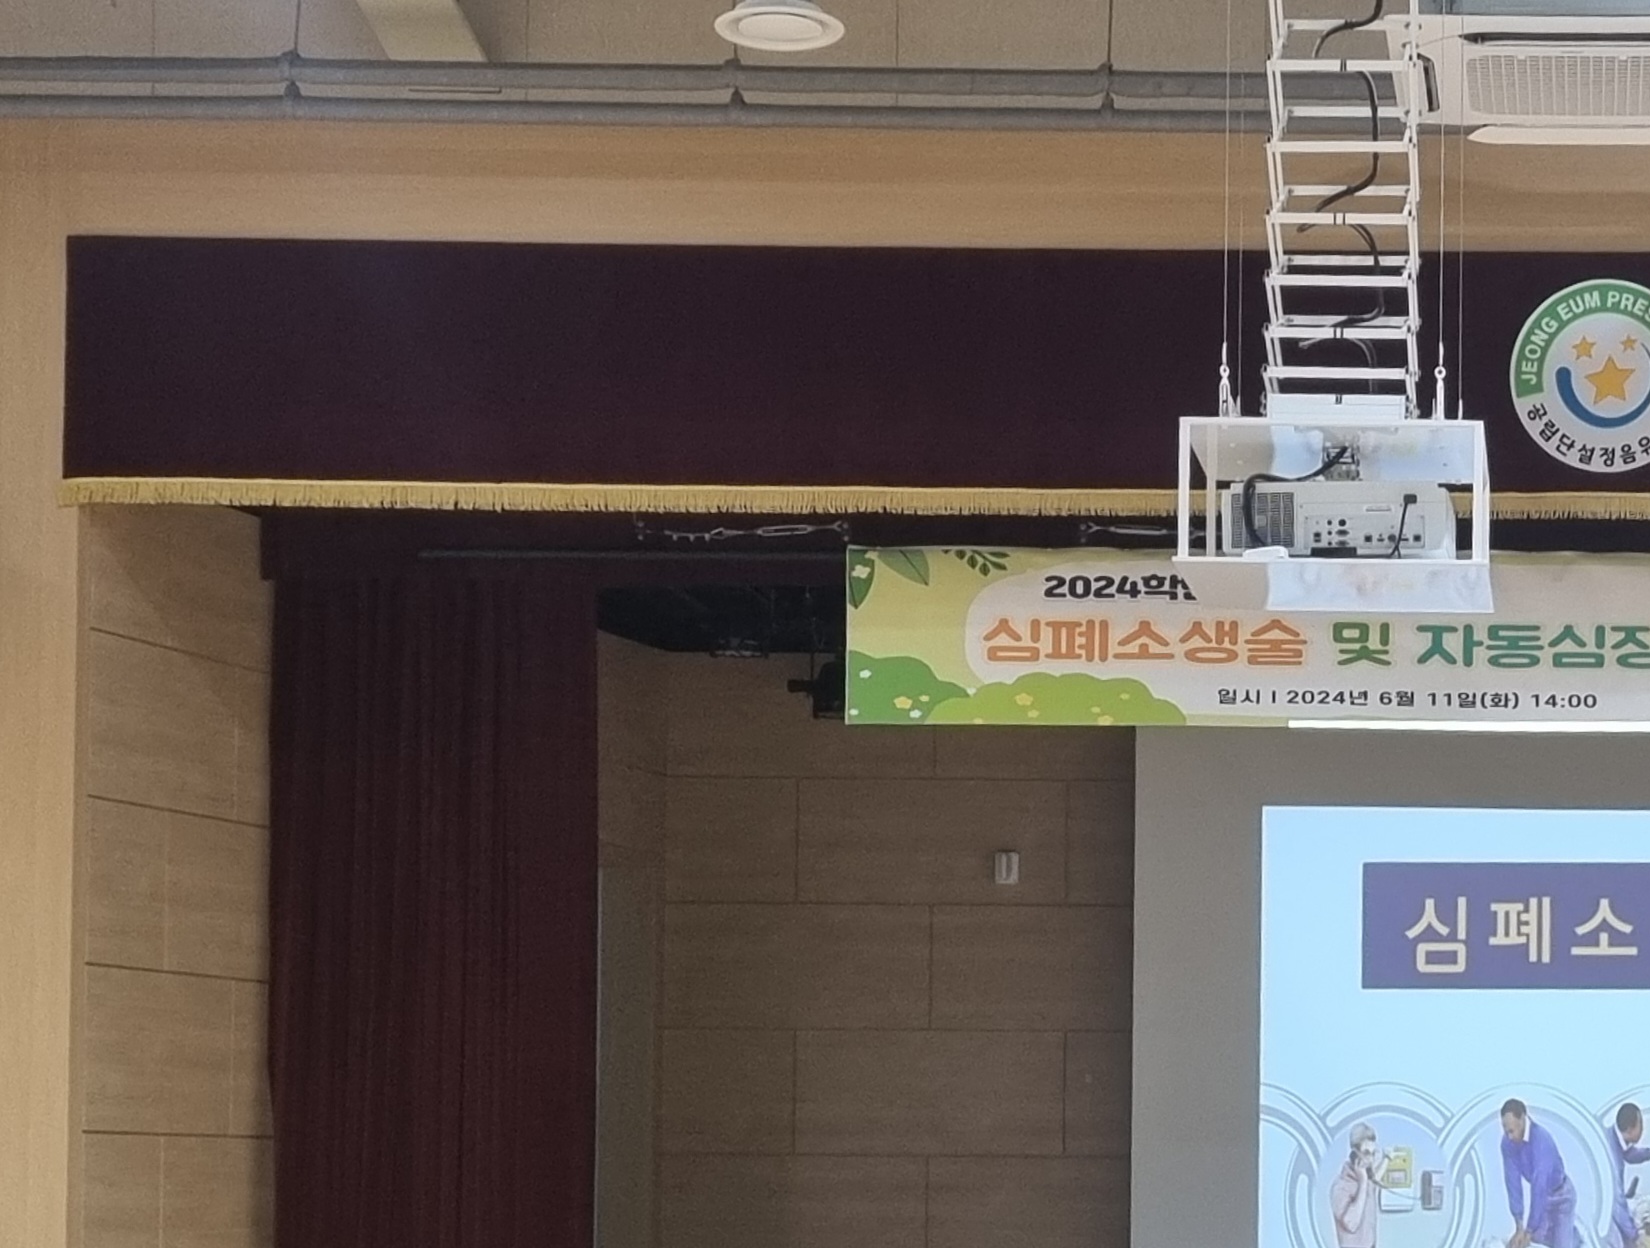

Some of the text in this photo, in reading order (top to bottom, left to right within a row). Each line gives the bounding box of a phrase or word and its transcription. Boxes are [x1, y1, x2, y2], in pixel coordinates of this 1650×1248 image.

[1521, 316, 1559, 385] JEONG
[1556, 290, 1601, 321] EUM
[1043, 573, 1198, 601] 2024학
[982, 617, 1308, 667] 심폐소생술
[1331, 620, 1393, 667] 및
[1217, 687, 1261, 706] 일시
[1286, 688, 1369, 707] 2024년
[1378, 690, 1415, 708] 6월
[1426, 691, 1520, 710] 11일(화)
[1530, 692, 1598, 709] 14:00
